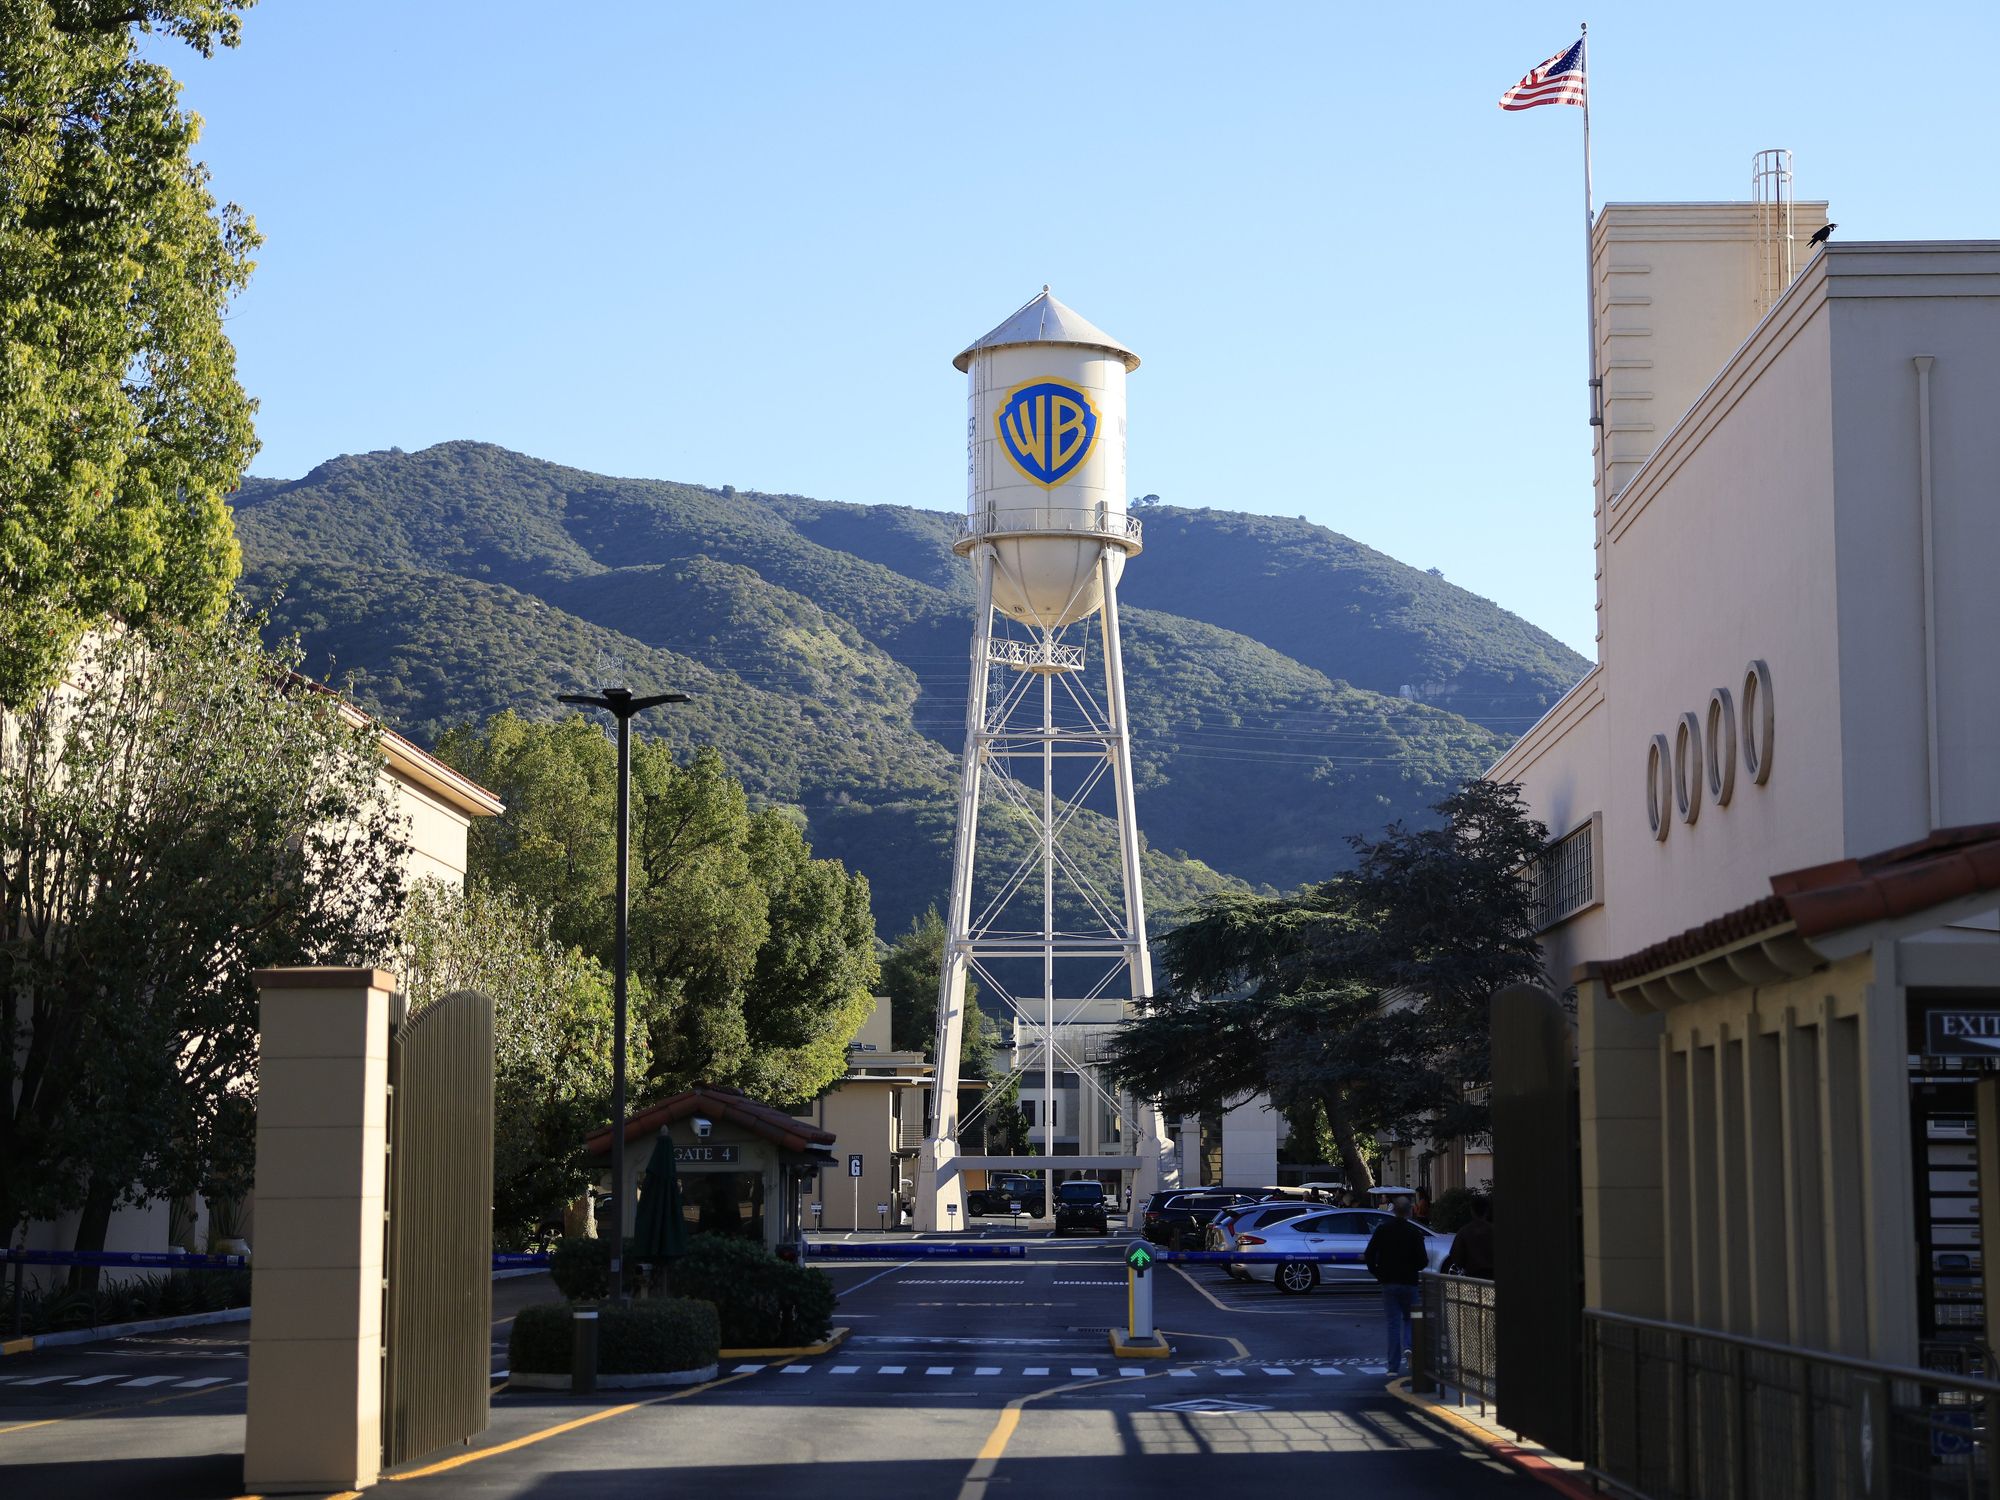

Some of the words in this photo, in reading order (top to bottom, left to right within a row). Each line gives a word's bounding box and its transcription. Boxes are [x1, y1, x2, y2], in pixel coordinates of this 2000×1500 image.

[1005, 394, 1087, 473] WB
[1943, 1015, 2000, 1035] EXIT
[673, 1147, 713, 1160] GATE
[722, 1147, 731, 1161] 4
[851, 1159, 860, 1176] G
